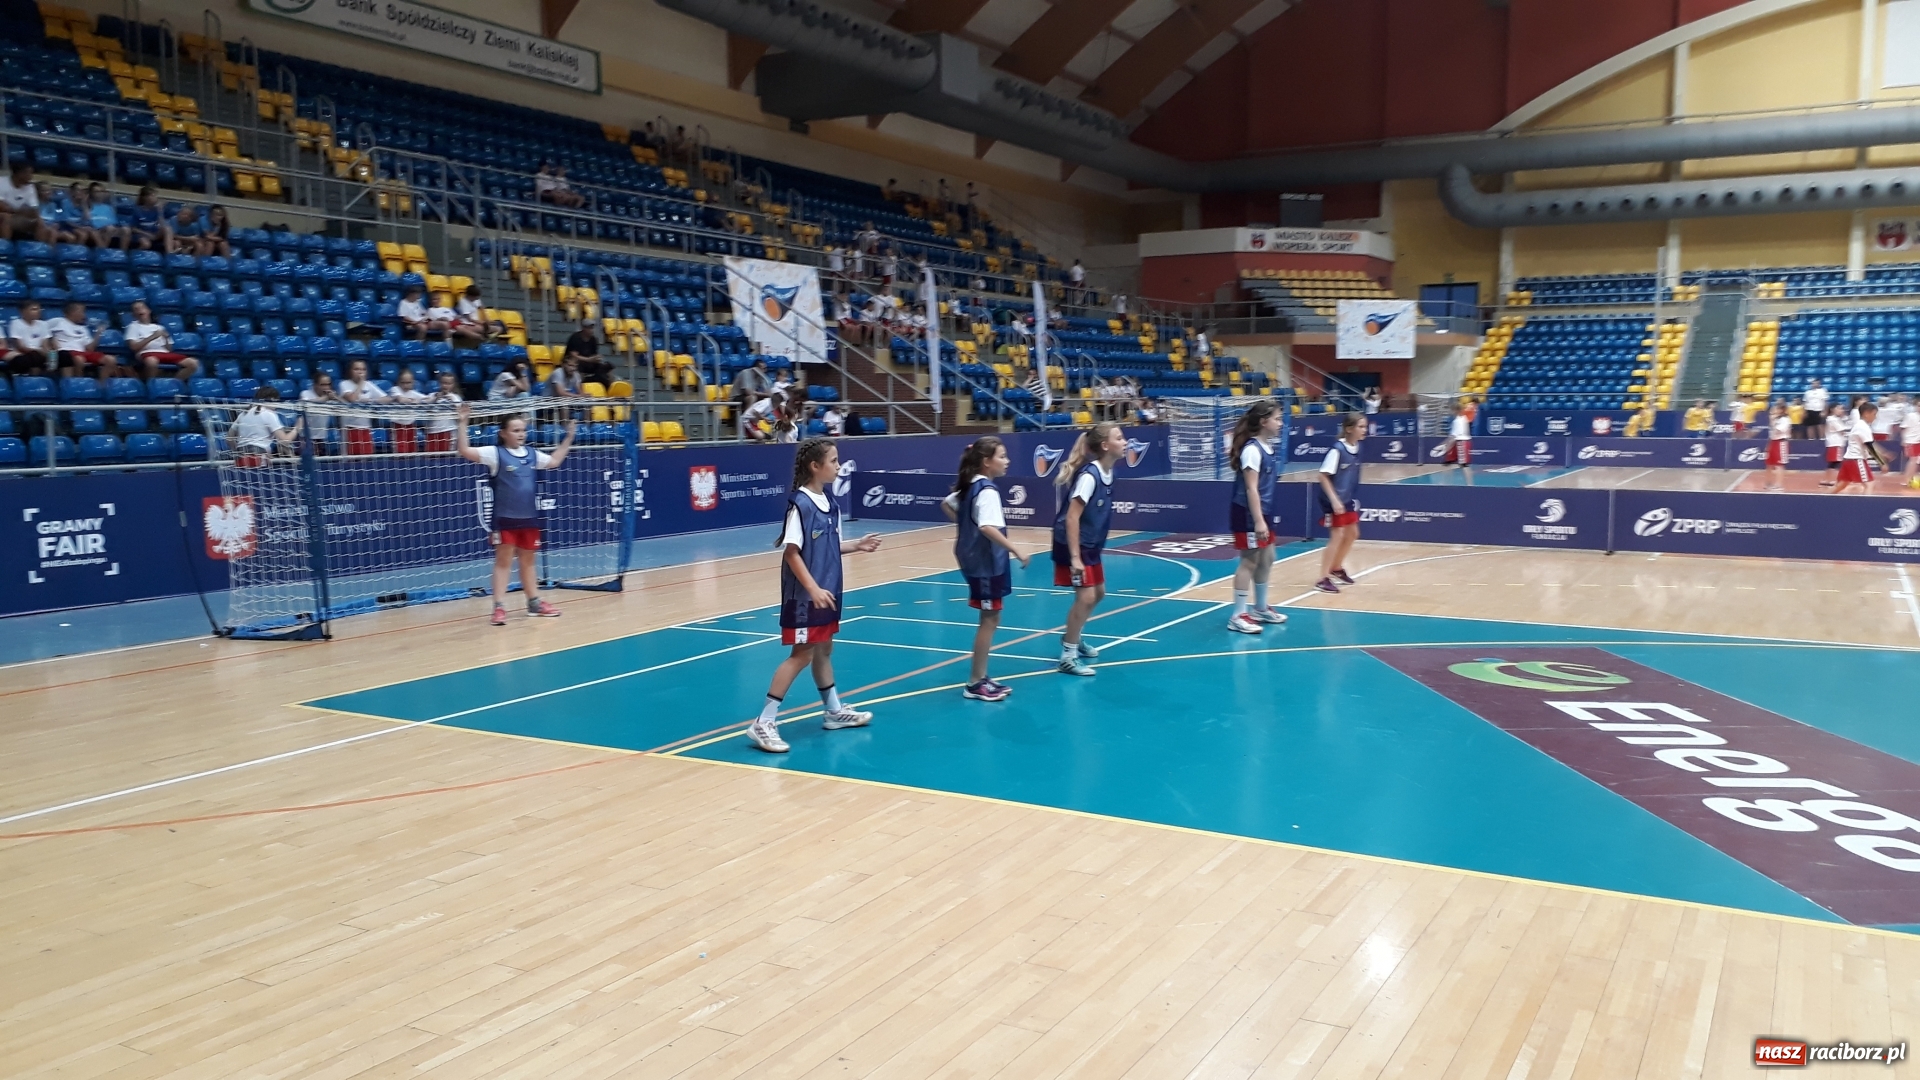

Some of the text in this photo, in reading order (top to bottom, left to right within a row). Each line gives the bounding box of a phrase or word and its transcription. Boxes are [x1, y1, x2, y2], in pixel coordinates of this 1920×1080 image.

[484, 29, 520, 52] Ziemi
[527, 41, 579, 71] Kaliskiej
[884, 493, 915, 505] ZPRP
[1359, 508, 1402, 522] ZPRP
[36, 517, 104, 535] GRAMY
[1671, 518, 1722, 534] ZPRP
[38, 533, 107, 558] FAIR
